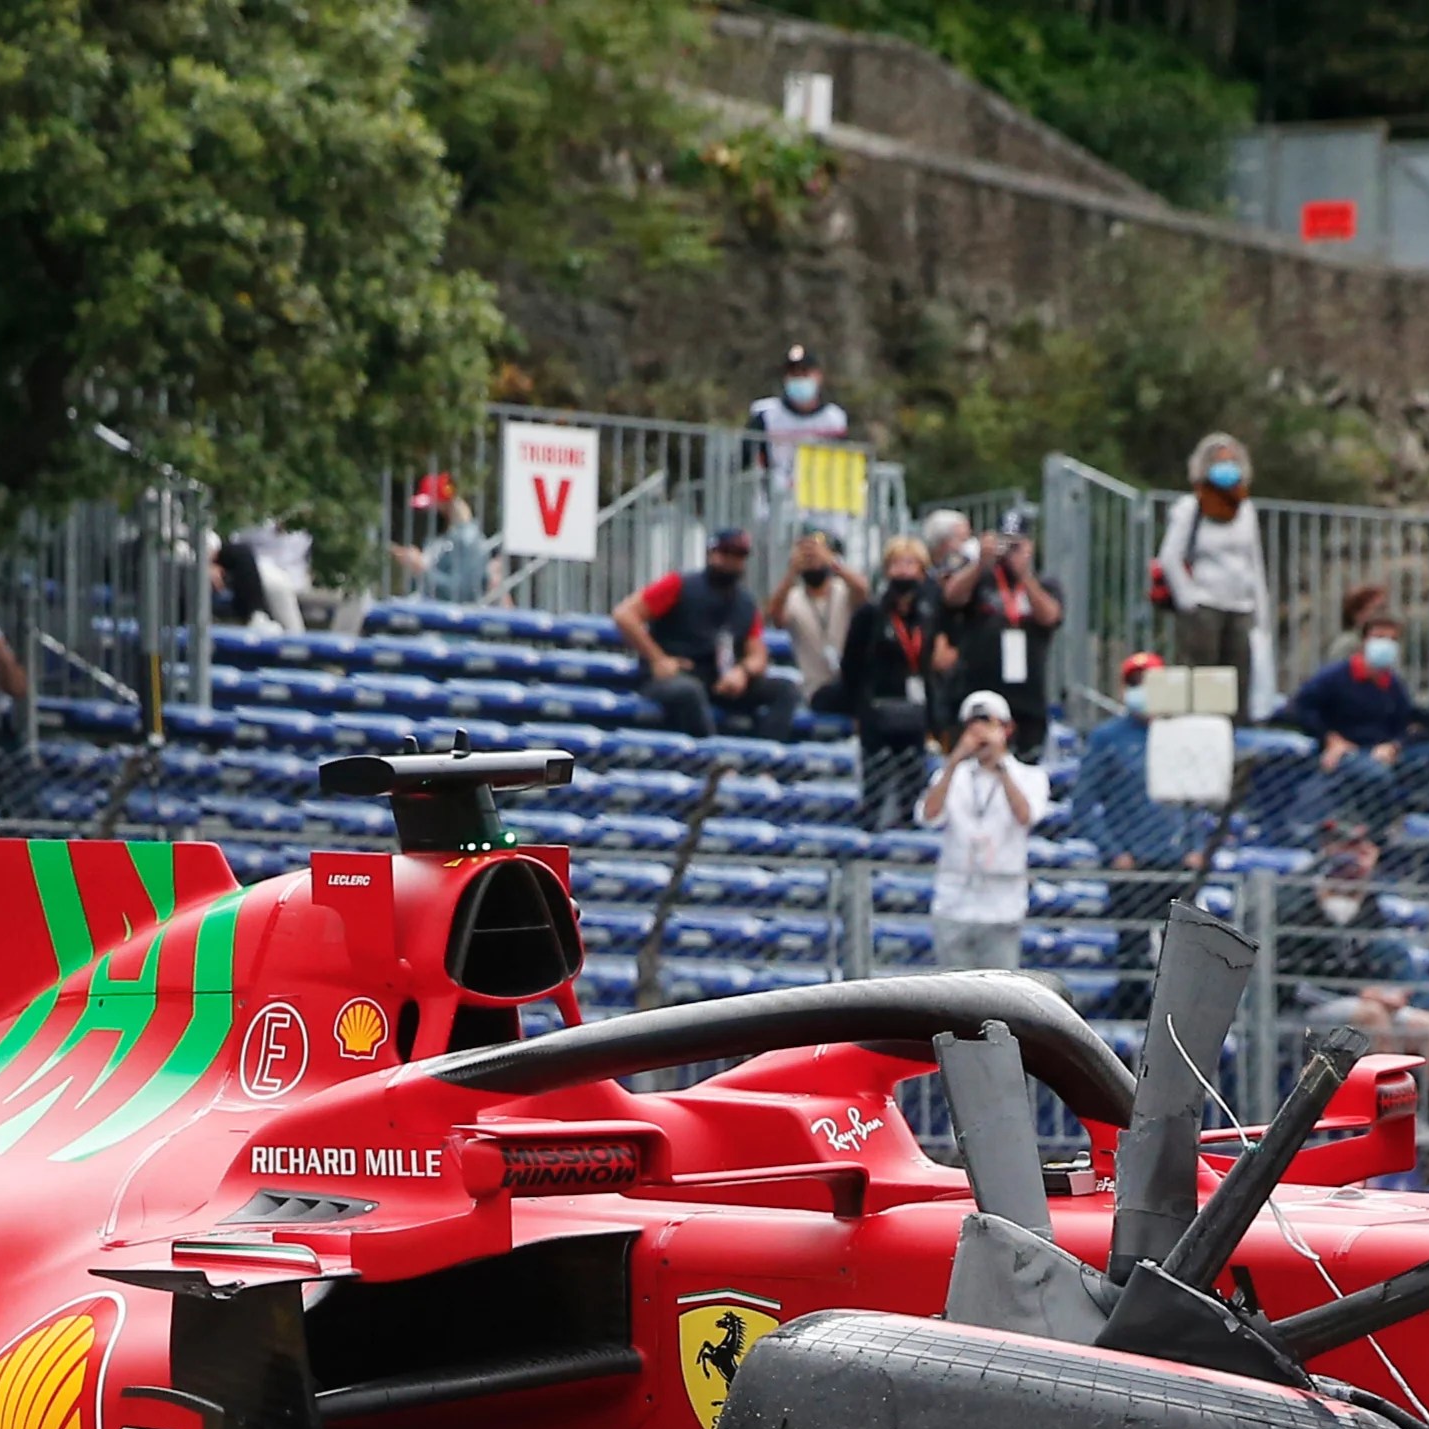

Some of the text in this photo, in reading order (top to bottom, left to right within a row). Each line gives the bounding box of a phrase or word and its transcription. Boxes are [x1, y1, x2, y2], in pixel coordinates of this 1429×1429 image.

[519, 442, 586, 467] TRIBUNE
[533, 475, 571, 536] V
[327, 874, 371, 886] LECLERC
[251, 1145, 443, 1178] RICHARD MILLE
[501, 1143, 637, 1167] MISSION
[501, 1165, 637, 1188] WINNOW
